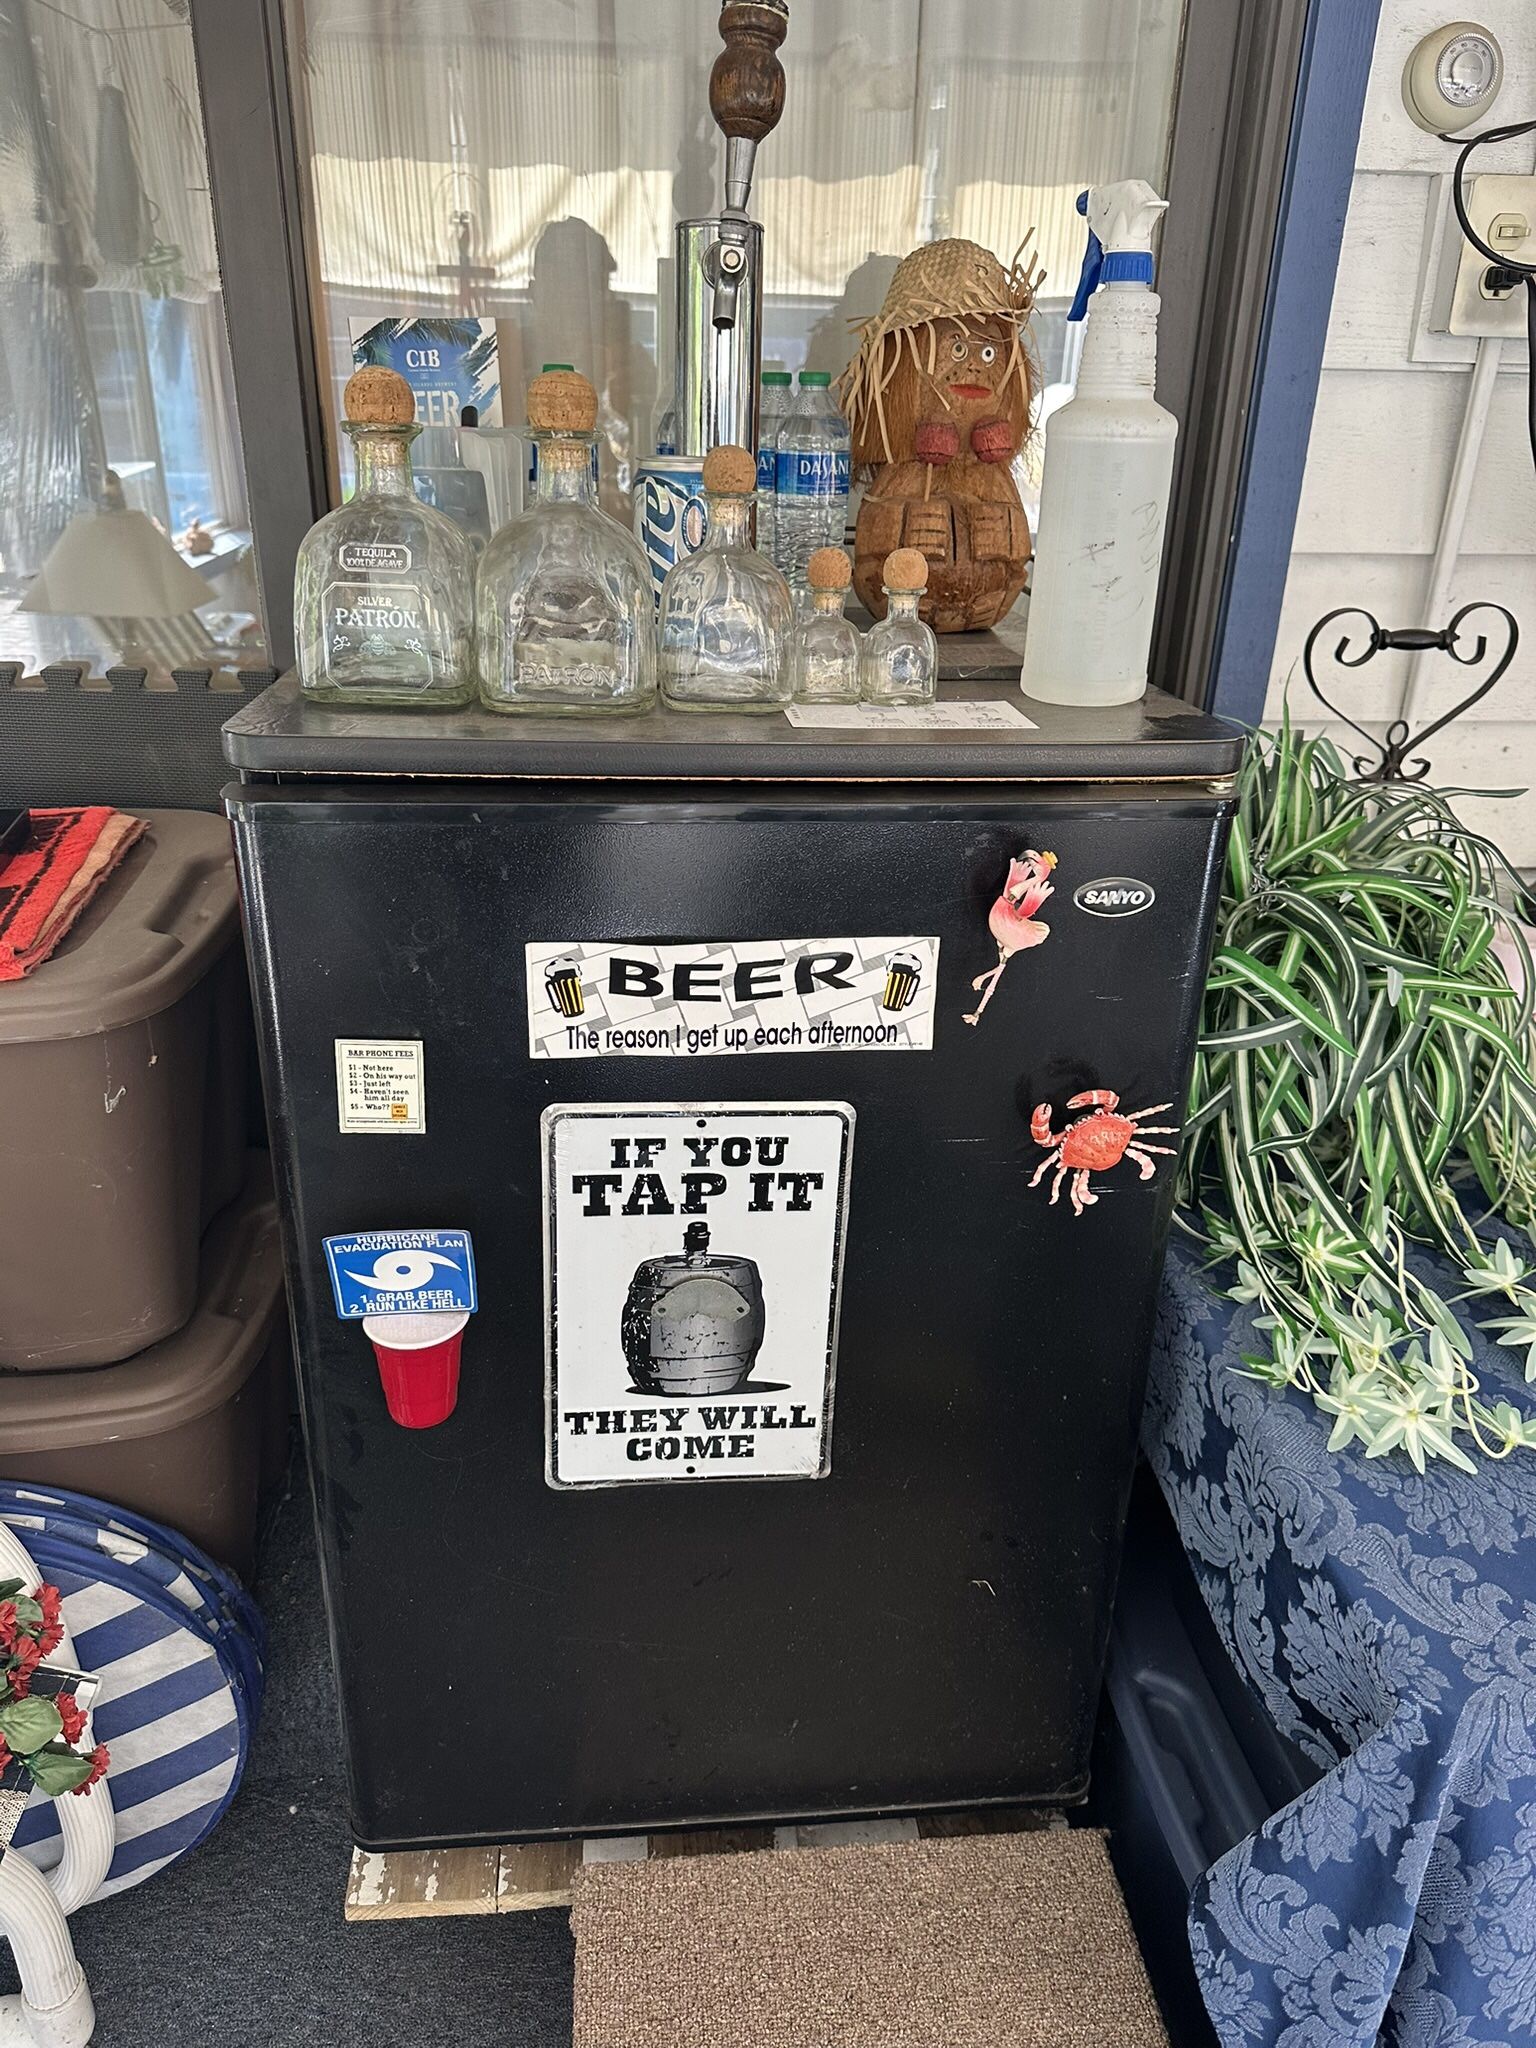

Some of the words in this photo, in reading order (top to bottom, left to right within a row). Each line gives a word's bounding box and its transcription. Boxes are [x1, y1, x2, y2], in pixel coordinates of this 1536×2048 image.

[406, 349, 440, 368] CIB
[800, 457, 849, 480] DASANI
[354, 548, 397, 558] TEQUILA
[376, 559, 403, 568] AGAVE
[357, 596, 392, 607] SILVER
[1084, 888, 1146, 907] SANYO
[608, 952, 856, 1002] BEER
[566, 1025, 600, 1050] The
[606, 1026, 668, 1049] reason
[676, 1025, 681, 1048] I
[686, 1024, 719, 1053] get
[724, 1026, 748, 1048] up
[753, 1023, 802, 1048] each
[808, 1022, 898, 1044] afternoon
[363, 1080, 378, 1088] Just
[610, 1137, 667, 1168] IF
[683, 1136, 790, 1167] YOU
[572, 1172, 728, 1216] TAP
[747, 1172, 825, 1212] IT
[334, 1240, 422, 1253] EVACUATION
[426, 1239, 464, 1249] PLAN
[356, 1233, 439, 1244] HURRICANE
[360, 1294, 374, 1303] 1.
[376, 1291, 415, 1302] GRAB
[418, 1289, 454, 1299] BEER
[349, 1304, 363, 1314] 2.
[366, 1301, 396, 1312] RUN
[400, 1301, 429, 1310] LIKE
[433, 1298, 466, 1309] HELL
[564, 1407, 690, 1436] THEY
[698, 1404, 817, 1431] WILL
[626, 1434, 756, 1462] COME
